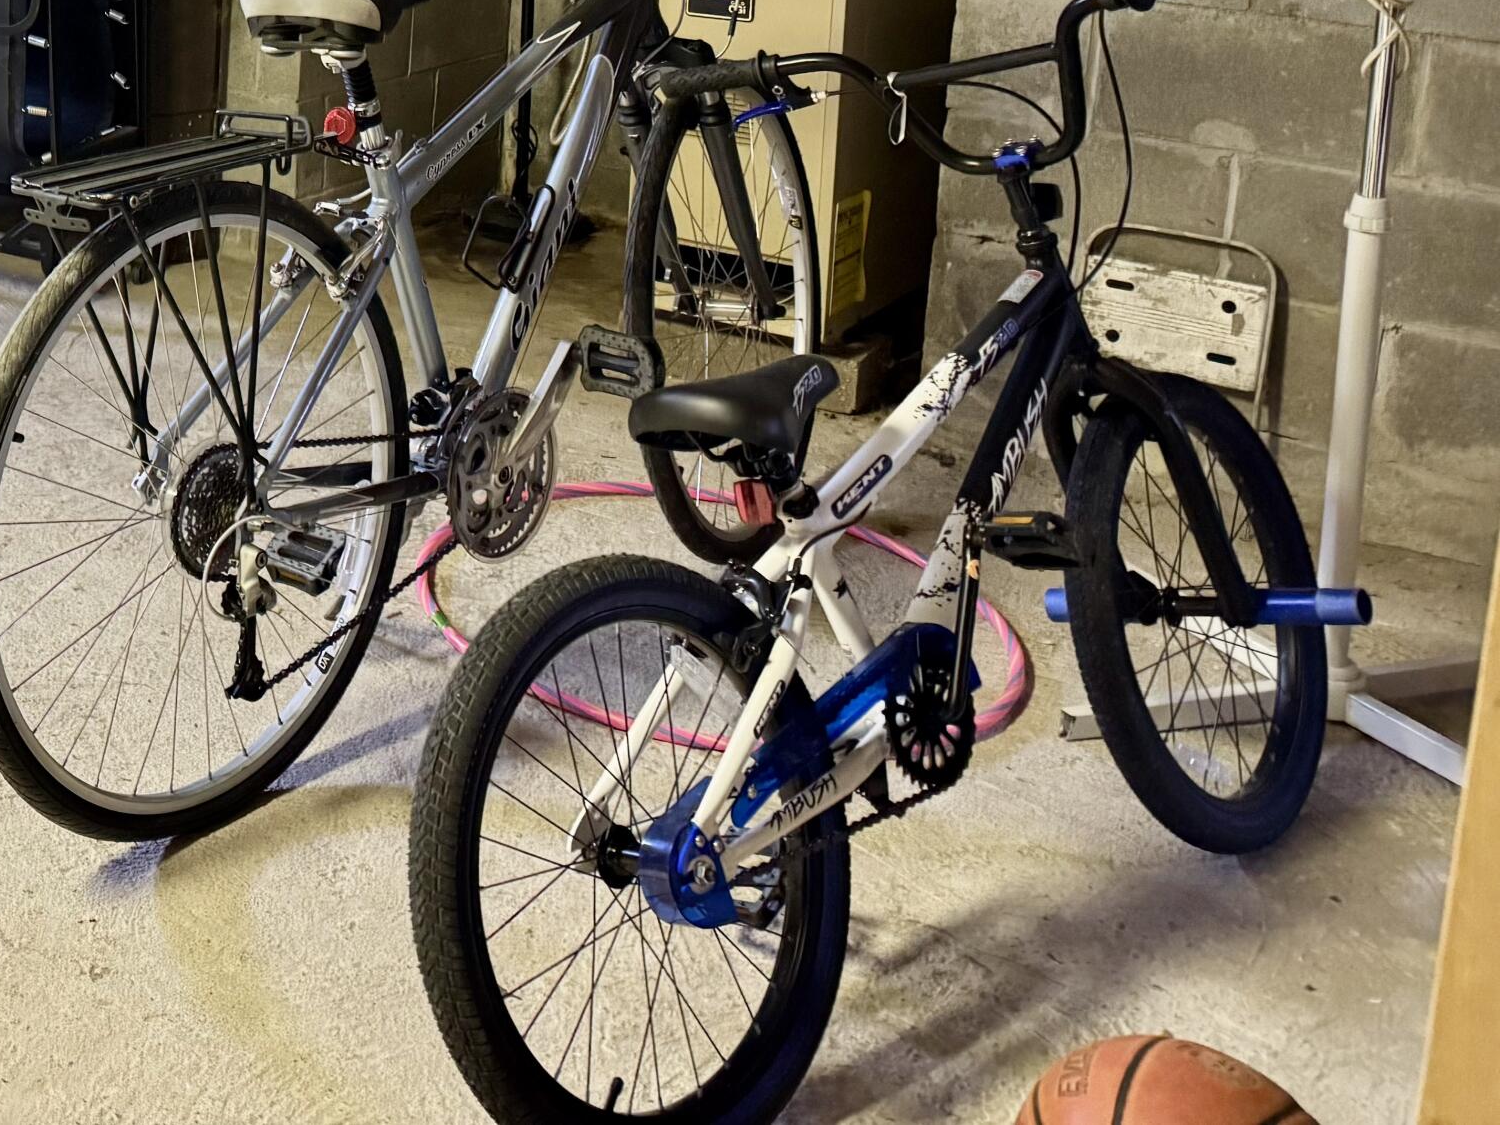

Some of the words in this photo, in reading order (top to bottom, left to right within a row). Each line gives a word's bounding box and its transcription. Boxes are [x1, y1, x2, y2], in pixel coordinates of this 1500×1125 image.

[426, 137, 466, 181] Cypress
[987, 376, 1048, 516] AMBUSH
[835, 456, 886, 513] KENT
[763, 773, 838, 833] AMBUSH
